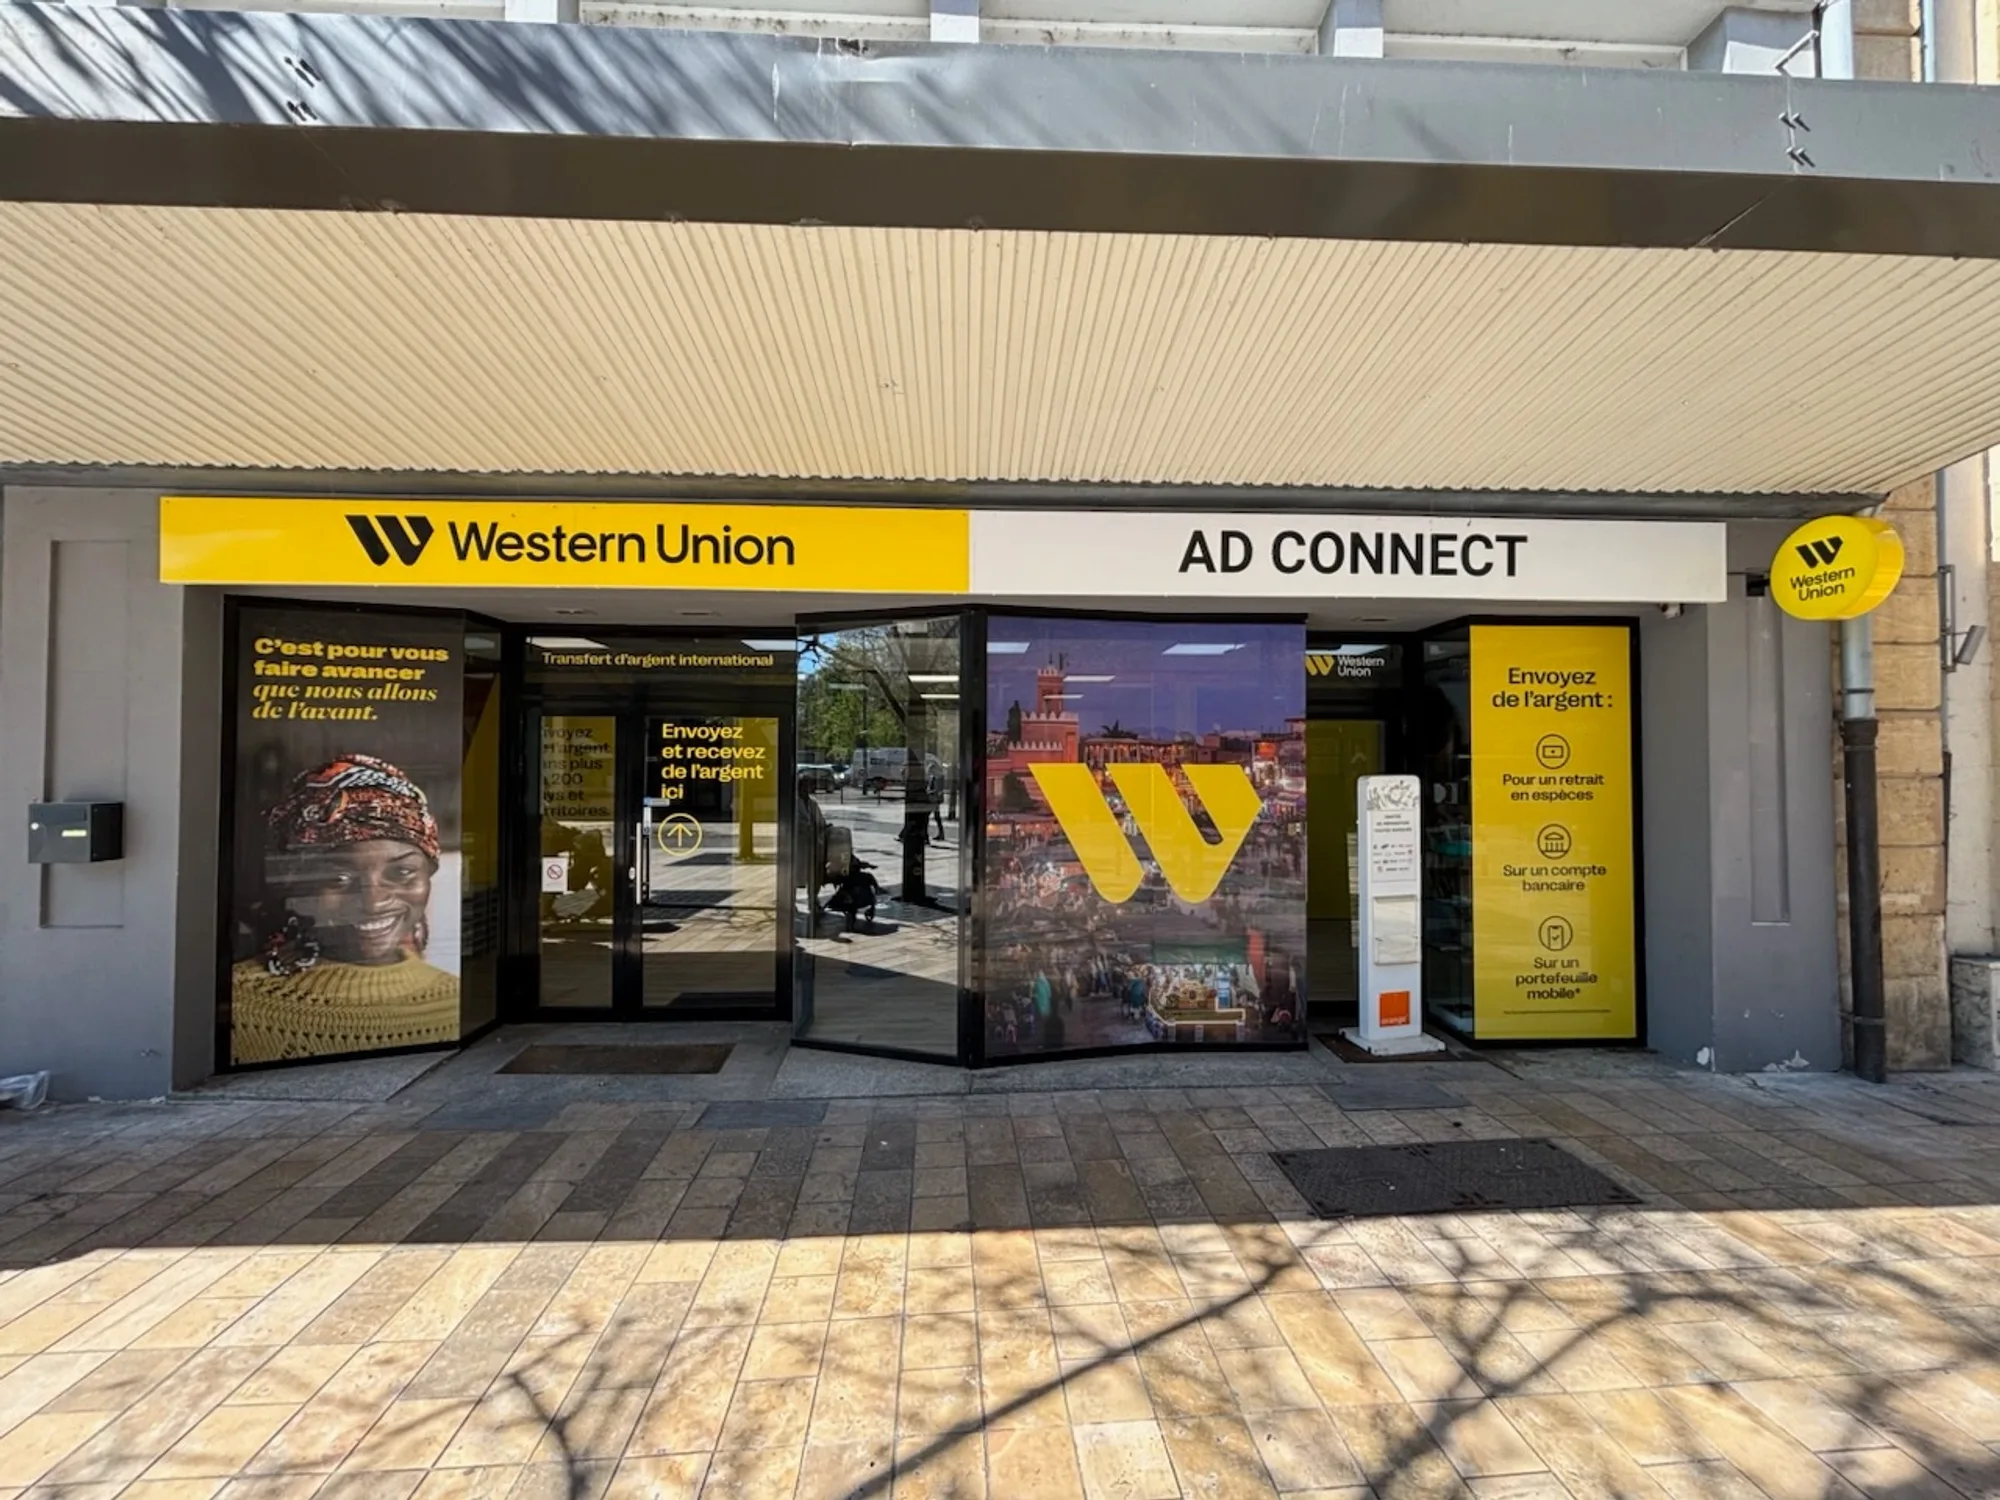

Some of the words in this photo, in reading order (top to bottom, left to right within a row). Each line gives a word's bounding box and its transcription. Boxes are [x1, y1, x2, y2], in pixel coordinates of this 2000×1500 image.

[449, 521, 647, 564] Western
[657, 525, 794, 567] Union
[1179, 531, 1252, 574] AD
[1271, 532, 1529, 578] CONNECT
[1790, 567, 1855, 590] Western
[1798, 583, 1845, 601] Union
[254, 638, 323, 657] C'est
[326, 646, 388, 661] pour
[390, 647, 449, 662] vous
[541, 652, 612, 666] Transfert
[614, 653, 677, 669] d'argent
[679, 654, 773, 667] international
[1337, 655, 1385, 667] Western
[253, 660, 318, 677] faire
[322, 665, 425, 681] avancer
[1337, 666, 1371, 677] Union
[1508, 668, 1596, 689] Envoyez
[252, 683, 300, 702] que
[304, 685, 363, 700] nous
[367, 683, 438, 701] allons
[1491, 690, 1520, 708] de
[252, 701, 283, 719] de
[287, 701, 378, 720] l'avant.
[662, 724, 744, 742] Envoyez
[661, 745, 682, 760] et
[686, 747, 766, 760] recevez
[570, 757, 604, 773] plus
[661, 764, 687, 780] de
[690, 763, 764, 783] l'argent
[551, 773, 583, 786] 200
[1503, 774, 1535, 786] Pour
[1538, 776, 1557, 786] un
[1559, 774, 1605, 786] retrait
[568, 789, 585, 802] et
[661, 784, 684, 800] ici
[1511, 790, 1529, 801] en
[1532, 788, 1594, 805] espèces
[544, 804, 610, 818] rritoires.
[1503, 864, 1528, 877] Sur
[1531, 867, 1549, 877] un
[1551, 865, 1607, 880] compte
[1522, 878, 1585, 892] bancaire
[1533, 957, 1559, 970] Sur
[1561, 959, 1580, 970] un
[1515, 972, 1598, 987] portefeuille
